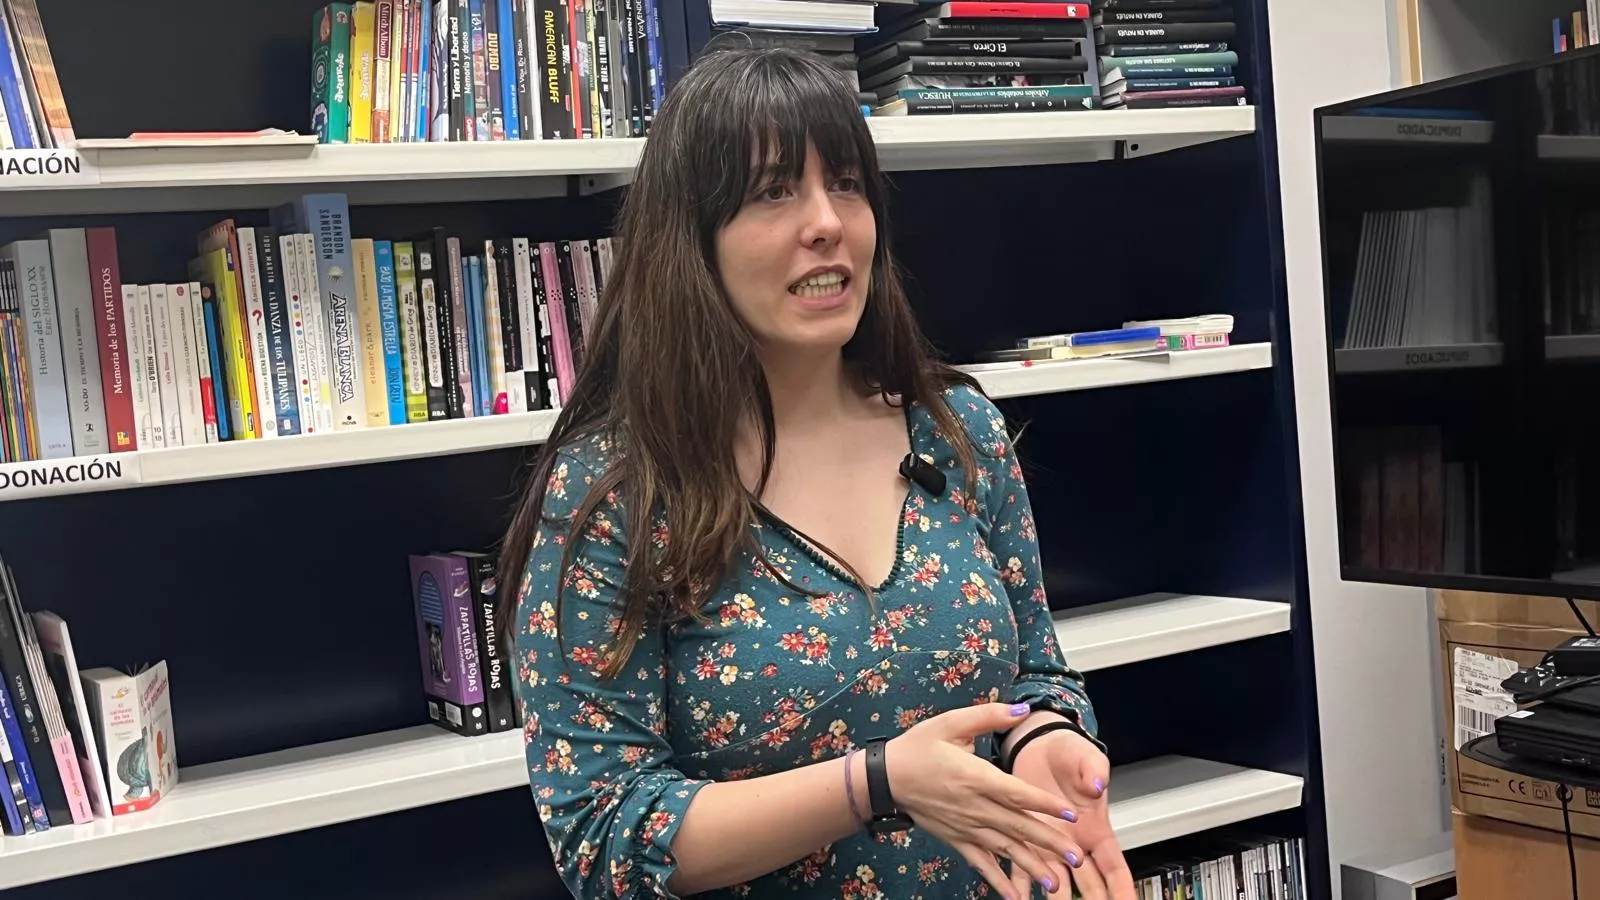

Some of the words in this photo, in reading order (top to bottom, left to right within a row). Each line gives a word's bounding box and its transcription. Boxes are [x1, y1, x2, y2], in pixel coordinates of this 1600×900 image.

[381, 3, 391, 28] Mitch
[379, 28, 390, 56] Albom
[450, 17, 460, 60] Libertad
[462, 32, 470, 54] deseo
[487, 32, 500, 71] DUMBO
[544, 10, 557, 65] AMERICAN
[973, 42, 997, 52] Circo
[451, 69, 461, 100] Tierra
[464, 61, 472, 94] Memoria
[548, 68, 560, 103] BLUFF
[918, 92, 951, 100] HUESCA
[997, 90, 1024, 98] notables
[0, 153, 80, 176] ACIÓN
[319, 209, 333, 260] SANDERSON
[332, 214, 344, 254] BRANDON
[27, 266, 37, 285] XX
[380, 266, 390, 284] BAJO
[30, 285, 41, 318] SIGLO
[101, 267, 115, 320] PARTIDOS
[382, 295, 393, 320] MISMA
[34, 320, 43, 336] del
[332, 294, 348, 344] ARENA
[408, 308, 416, 325] Greg
[426, 306, 436, 321] Greg
[108, 322, 117, 337] los
[110, 338, 119, 350] de
[383, 320, 396, 356] ESTRELLA
[429, 329, 438, 354] DIARIO
[39, 338, 49, 376] Historia
[270, 302, 282, 335] DANZA
[276, 360, 290, 410] TULIPANES
[410, 334, 419, 359] DIARIO
[112, 352, 124, 394] Memoria
[147, 356, 156, 381] O'BRIEN
[338, 346, 354, 404] BLANCA
[459, 606, 472, 660] ZAPATILLAS
[468, 662, 478, 693] ROJAS
[483, 603, 496, 656] ZAPATILLAS
[490, 659, 500, 689] ROJAS
